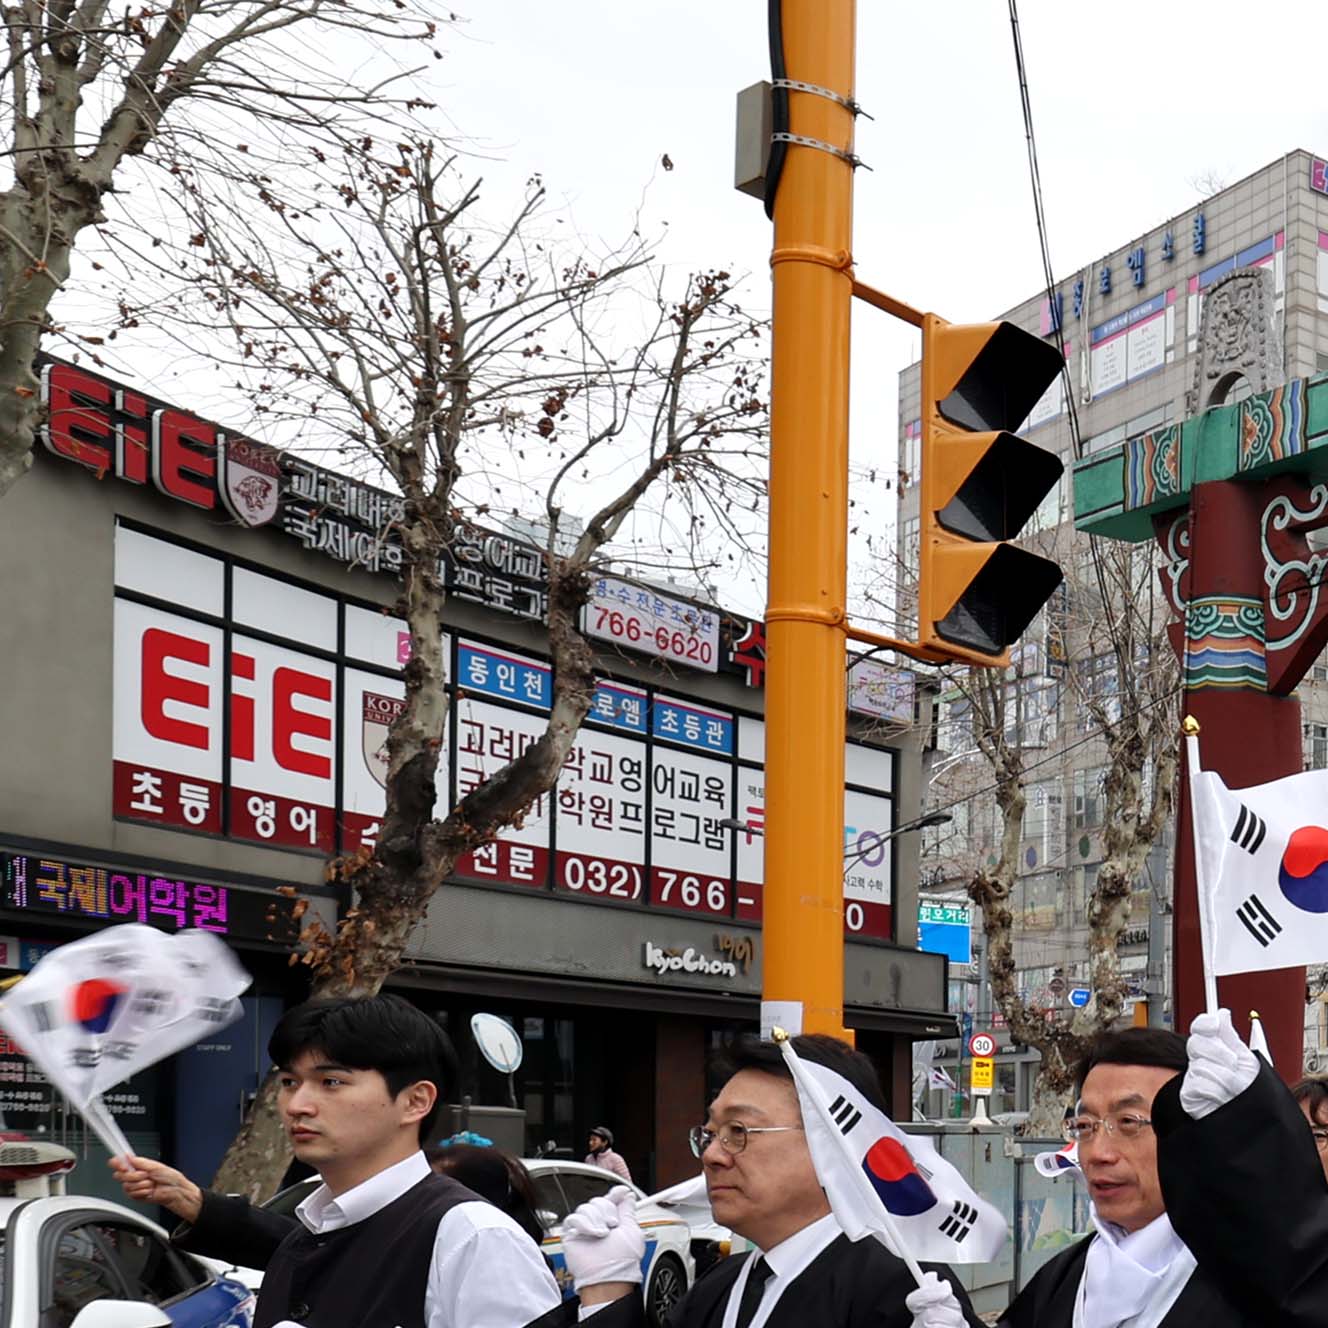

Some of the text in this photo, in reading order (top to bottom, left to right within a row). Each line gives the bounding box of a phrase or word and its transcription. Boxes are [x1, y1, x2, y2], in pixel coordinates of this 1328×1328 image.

[453, 522, 550, 581] 영어교
[452, 566, 551, 626] 프로그
[594, 605, 713, 665] 766-6620
[467, 655, 724, 747] 동인천 로엠 초등관
[918, 906, 971, 925] 림오거리
[975, 1039, 990, 1051] 30
